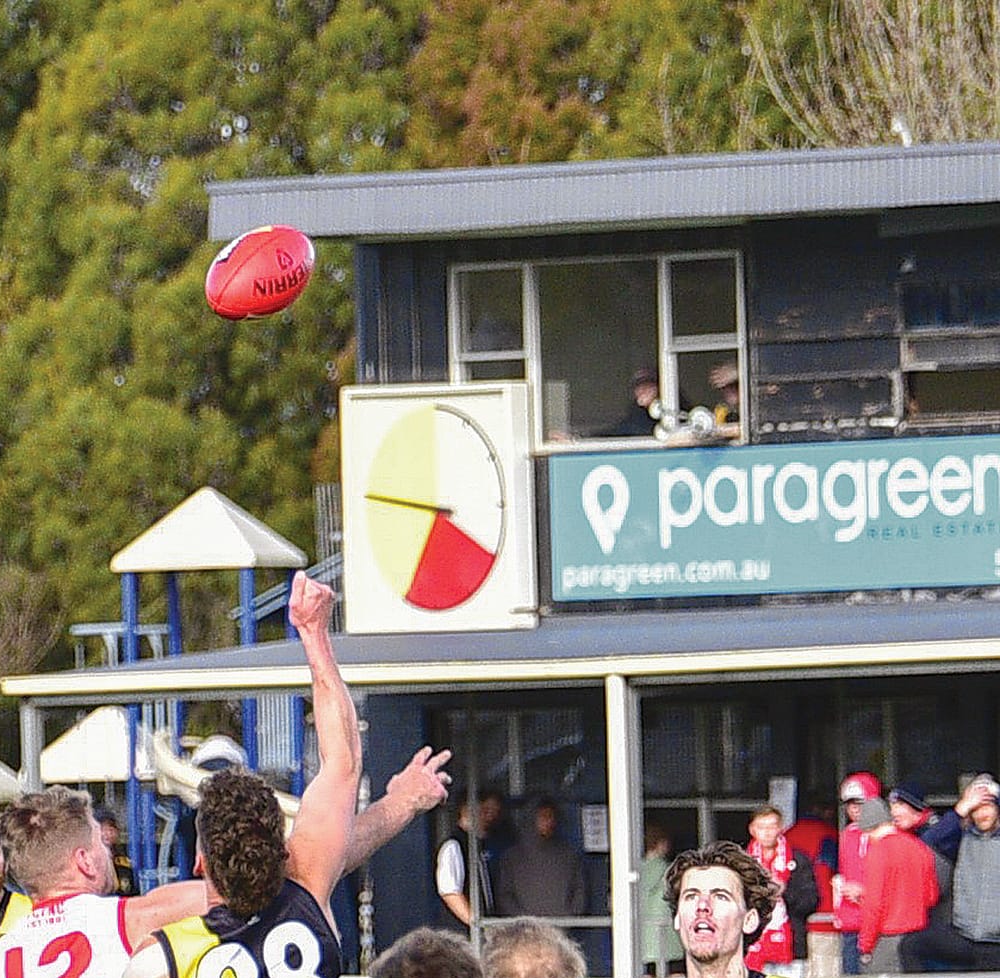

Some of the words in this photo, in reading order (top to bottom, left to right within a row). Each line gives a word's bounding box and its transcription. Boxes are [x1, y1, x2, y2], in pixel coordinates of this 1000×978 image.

[658, 454, 1000, 549] paragreen
[866, 523, 921, 540] REAL
[932, 519, 1000, 538] ESTAT
[562, 560, 771, 593] paragreen.com.au
